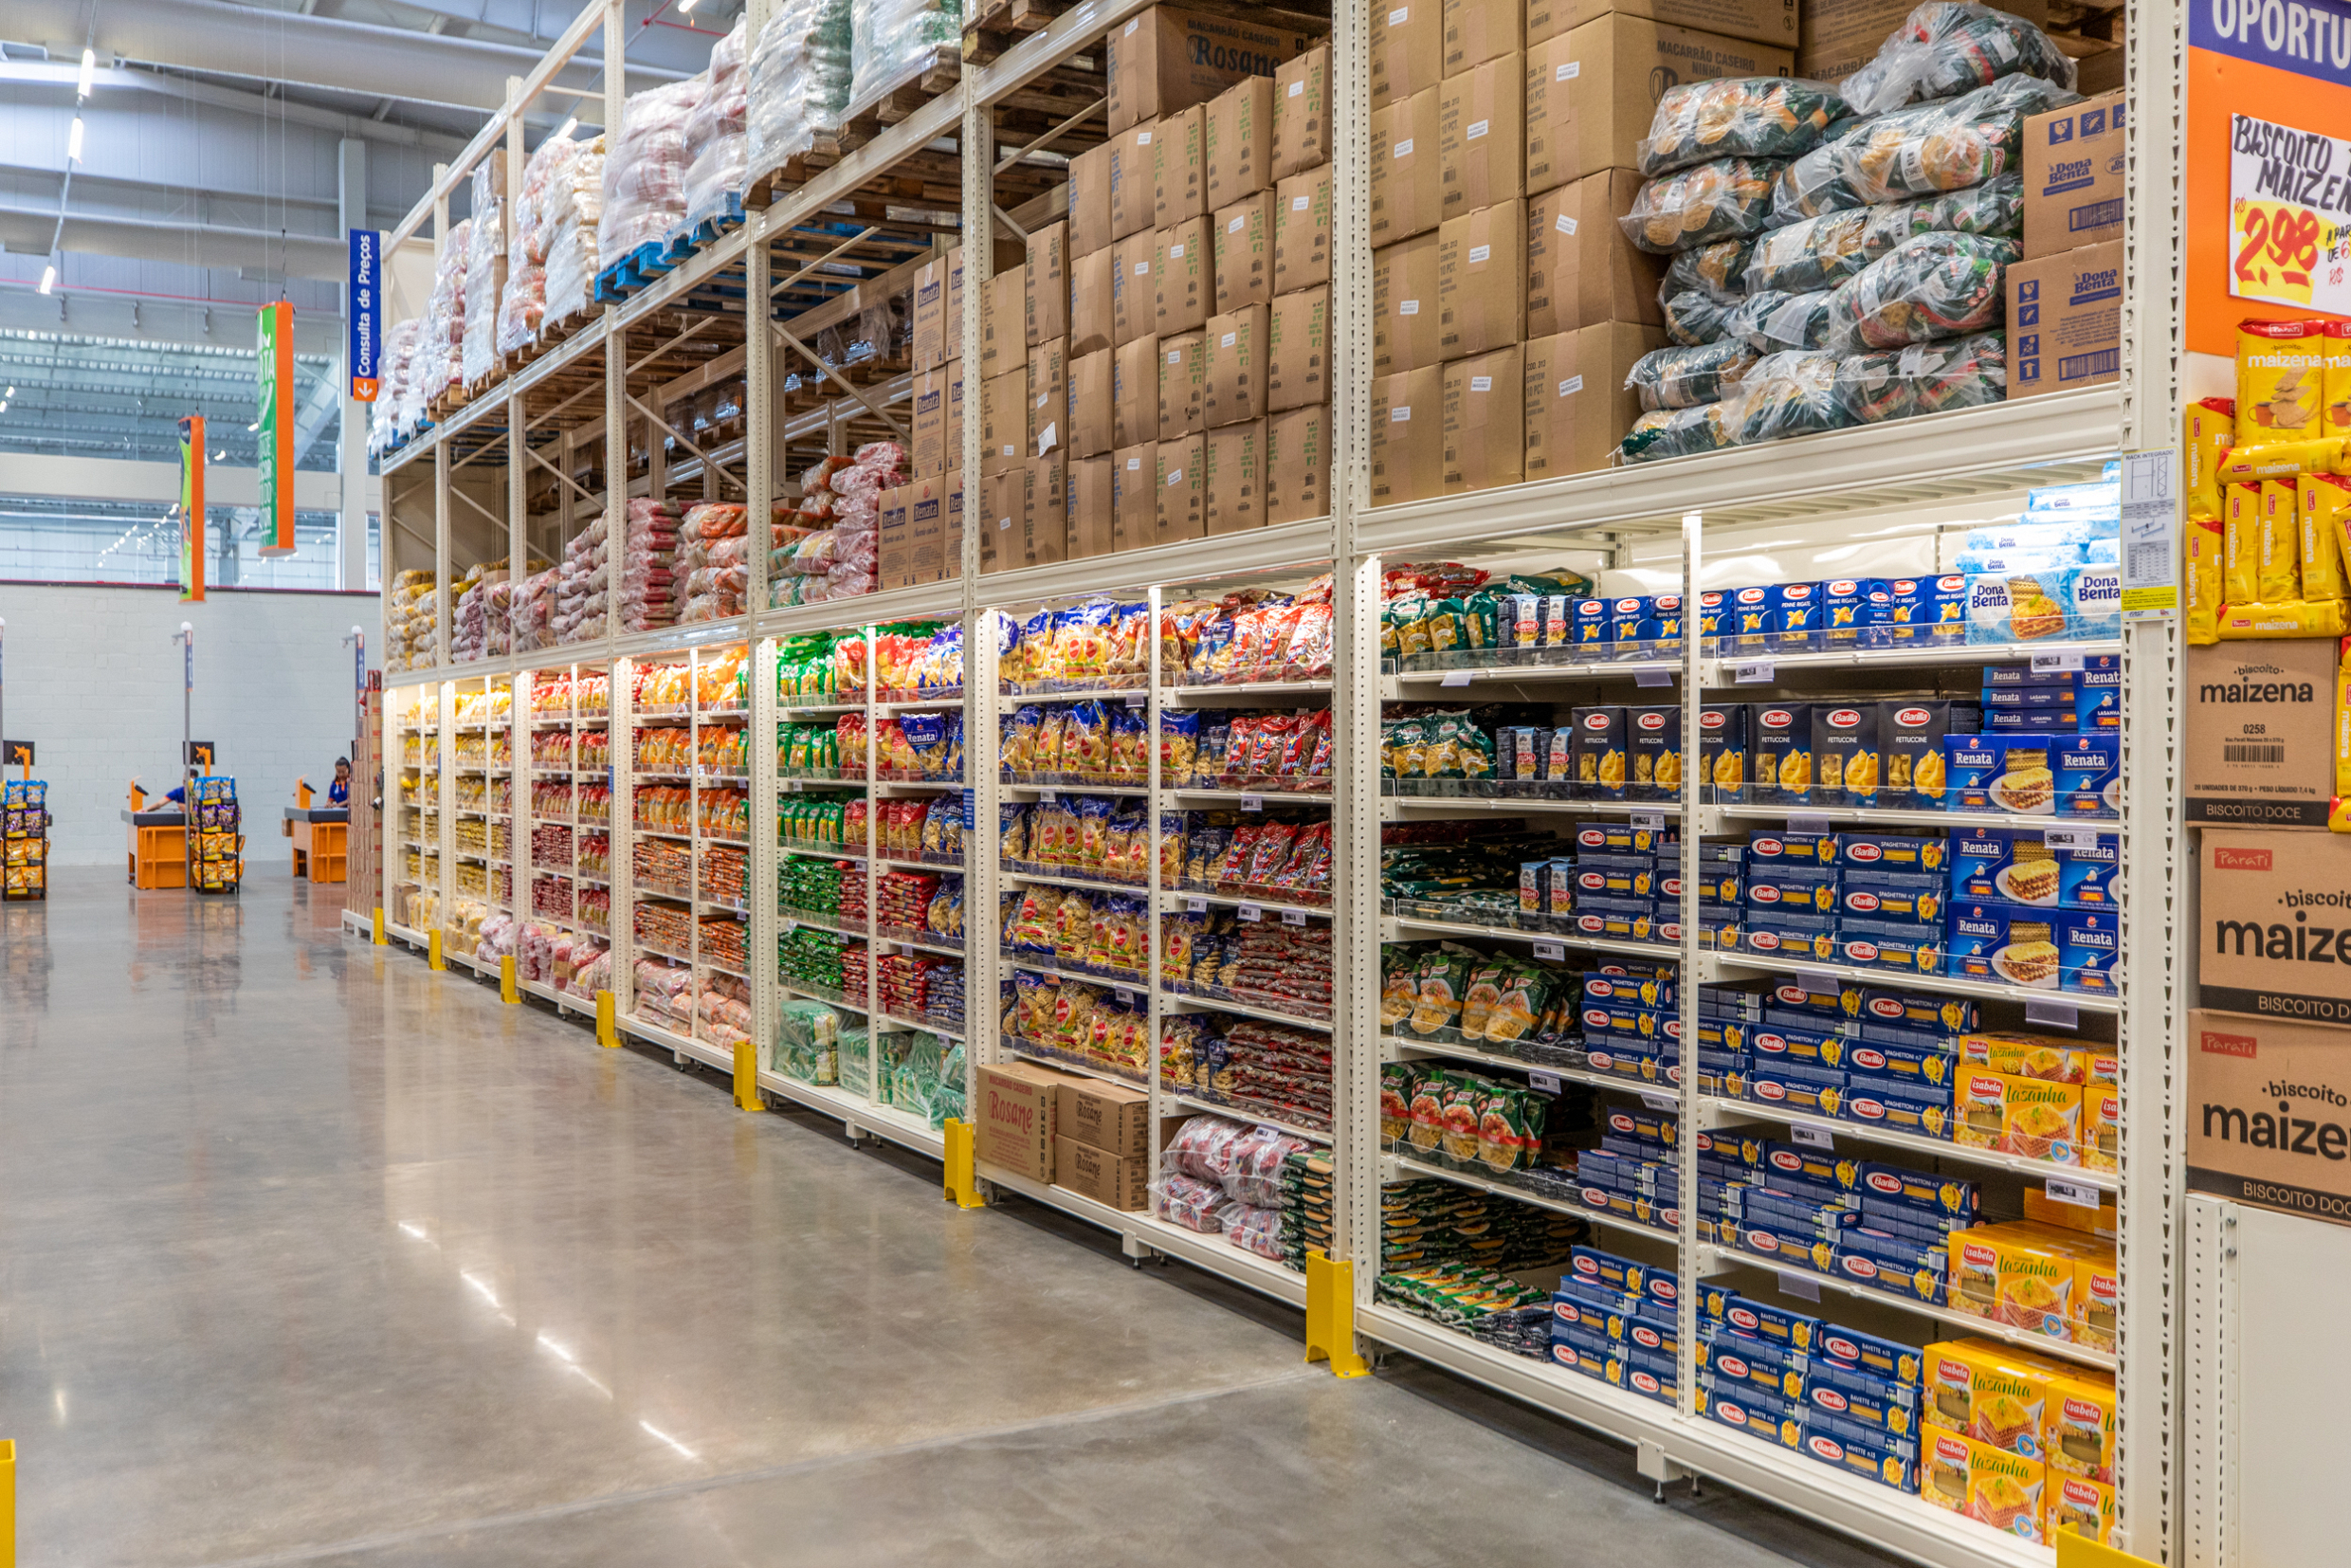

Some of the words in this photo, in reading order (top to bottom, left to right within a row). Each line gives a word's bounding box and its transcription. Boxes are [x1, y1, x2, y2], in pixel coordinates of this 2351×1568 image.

[1656, 40, 1712, 62] MACARRÃO
[1715, 52, 1756, 72] CASEIRO
[2233, 114, 2333, 175] BISCOITO
[2056, 158, 2092, 173] Dona
[2049, 168, 2090, 184] Benta
[2234, 193, 2247, 214] R$
[357, 234, 373, 284] Preços
[2327, 246, 2340, 263] DE
[2082, 269, 2118, 283] Dona
[2329, 266, 2343, 286] R$
[2074, 278, 2115, 294] Benta
[357, 288, 371, 308] de
[919, 285, 939, 306] Renata
[357, 312, 371, 376] Consulta
[2248, 351, 2322, 368] maizena
[918, 392, 939, 414] Renata
[2141, 449, 2175, 459] INTEGRADO
[2191, 443, 2200, 487] maizena
[2256, 463, 2300, 474] maizena
[915, 501, 938, 521] Renata
[2229, 523, 2238, 568] maizena
[2264, 520, 2273, 566] maizena
[2305, 517, 2316, 563] maizena
[1834, 582, 1856, 593] Barilla
[2083, 576, 2119, 588] Dona
[1743, 591, 1764, 601] Barilla
[1788, 587, 1811, 597] Barilla
[1977, 585, 2005, 595] Dona
[2078, 587, 2121, 602] Benta
[1584, 603, 1601, 612] Barilla
[1971, 593, 2009, 609] Benta
[2255, 619, 2299, 630] maizena
[1993, 670, 2020, 681] Renata
[2238, 664, 2280, 675] biscoito
[2085, 671, 2121, 684] Renat
[1992, 692, 2019, 702] Renata
[2200, 676, 2313, 703] maizena
[1767, 714, 1791, 724] Barilla
[1835, 713, 1859, 723] Barilla
[1903, 712, 1928, 722] Barilla
[1994, 714, 2021, 723] Renata
[2243, 723, 2266, 734] 0258
[907, 732, 938, 743] Renata
[1956, 752, 1993, 765] Renata
[2064, 754, 2105, 767] Renata
[2206, 804, 2263, 817] BISCOITO
[2265, 806, 2301, 819] DOCE
[1584, 834, 1603, 843] Barilla
[1759, 842, 1781, 853] Barilla
[1854, 848, 1880, 858] Barilla
[1961, 841, 1999, 855] Renata
[2217, 850, 2269, 866] Parati
[1757, 889, 1779, 900] Barilla
[1853, 897, 1877, 907] Barilla
[1959, 920, 1996, 935] Renata
[2070, 930, 2113, 946] Renata
[2216, 910, 2351, 966] maize
[1876, 1002, 1902, 1013] Barilla
[2258, 995, 2334, 1016] BISCOITO
[1967, 1043, 1988, 1052] isabela
[1989, 1048, 2025, 1059] Lasanha
[2204, 1035, 2254, 1054] Parati
[1859, 1053, 1884, 1066] Barilla
[2096, 1062, 2117, 1070] isabela
[989, 1074, 1012, 1090] MACARRÃO
[1012, 1083, 1032, 1097] CASEIRO
[1972, 1079, 2001, 1093] isabela
[2006, 1085, 2069, 1103] Lasanha
[2269, 1079, 2347, 1107] biscoito
[987, 1090, 1033, 1135] Rosane
[1076, 1101, 1103, 1125] Rosane
[2202, 1101, 2351, 1161] maize
[1075, 1153, 1101, 1178] Rosane
[1874, 1176, 1900, 1190] Barilla
[2243, 1181, 2316, 1208] BISCOITO
[1965, 1247, 1994, 1262] isabela
[1998, 1254, 2059, 1278] Lasanha
[1734, 1313, 1757, 1325] Barilla
[1760, 1312, 1777, 1322] BAVETTE
[1832, 1342, 1857, 1357] Barilla
[1862, 1342, 1881, 1354] BAVETTE
[1940, 1363, 1968, 1379] isabela
[1973, 1372, 2033, 1398] Lasanha
[1819, 1394, 1845, 1408] Barilla
[1850, 1394, 1869, 1406] BAVETTE
[2066, 1402, 2099, 1419] isabela
[1816, 1442, 1842, 1457] Barilla
[1847, 1443, 1866, 1455] BAVETTE
[1938, 1440, 1967, 1457] isabela
[1971, 1450, 2031, 1479] Lasanha
[2065, 1484, 2098, 1502] isabela
